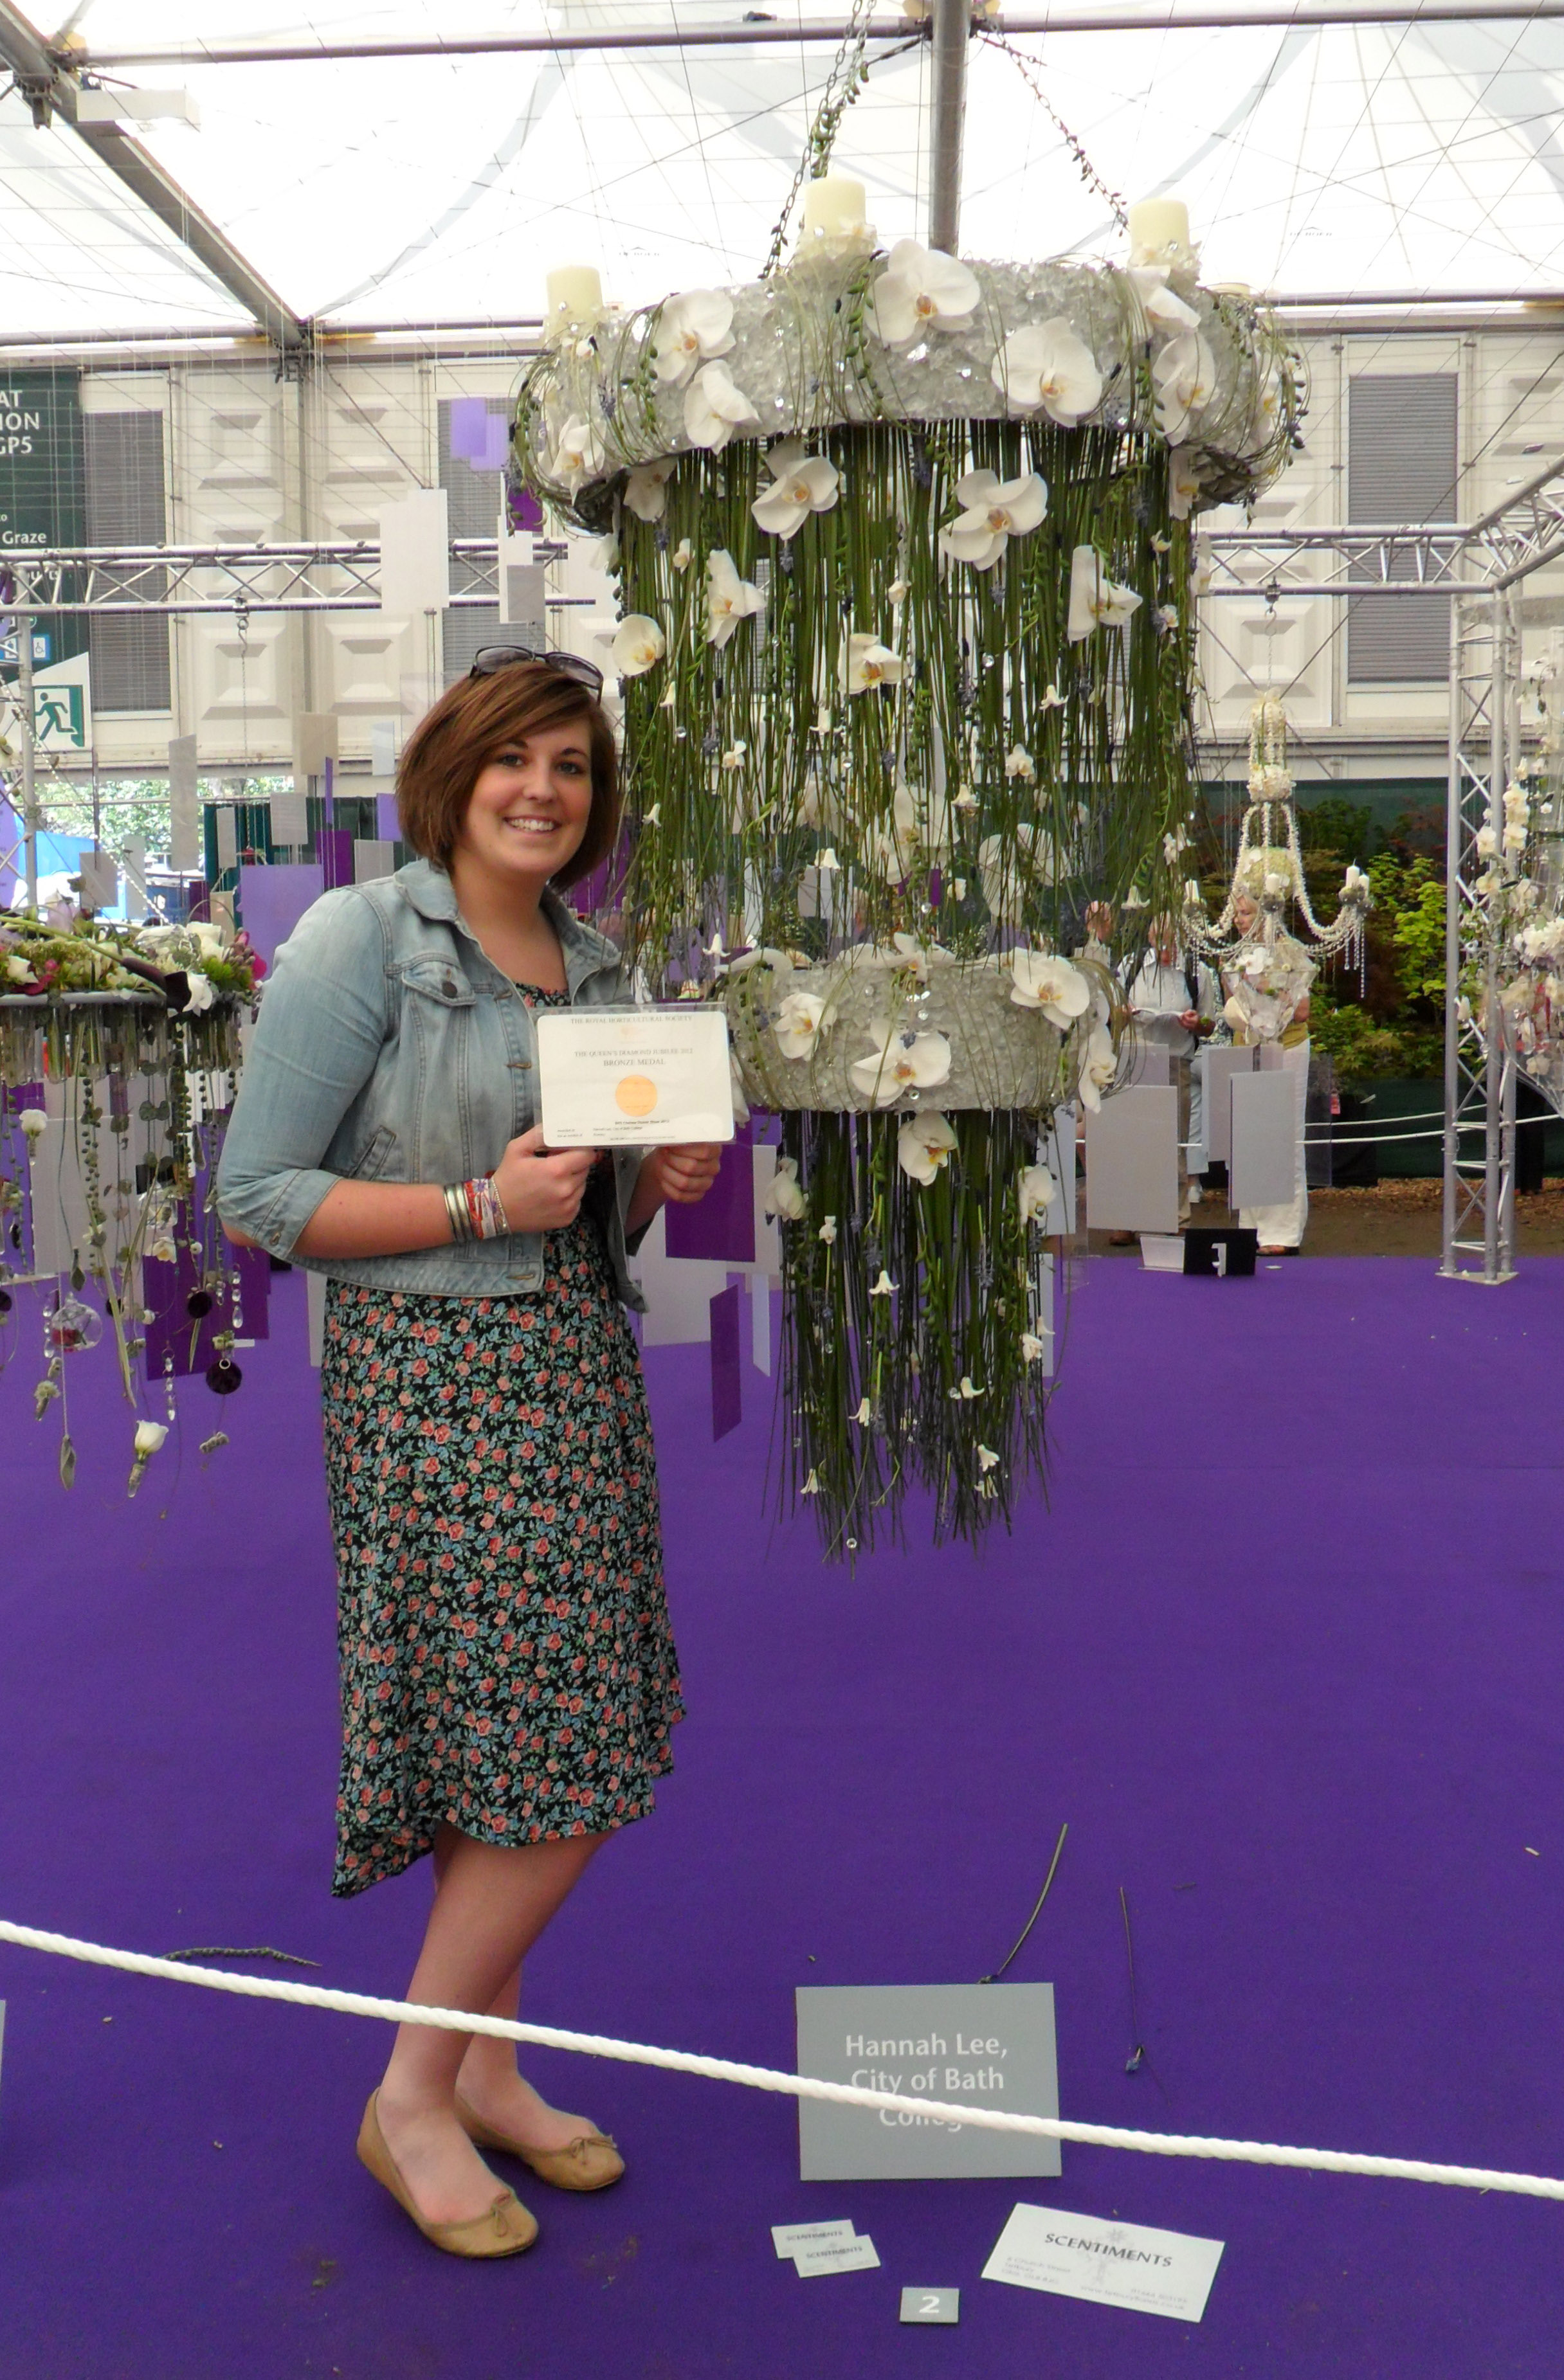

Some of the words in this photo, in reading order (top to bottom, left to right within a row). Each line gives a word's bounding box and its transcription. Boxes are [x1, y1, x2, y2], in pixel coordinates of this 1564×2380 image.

[2, 531, 47, 545] Graze
[845, 2033, 947, 2057] Hannah
[956, 2033, 1008, 2059] Lee,
[851, 2068, 903, 2095] City
[911, 2067, 938, 2091] of
[945, 2066, 1005, 2090] Bath
[1045, 2233, 1173, 2267] SCENTIMENTS
[919, 2295, 940, 2314] 2
